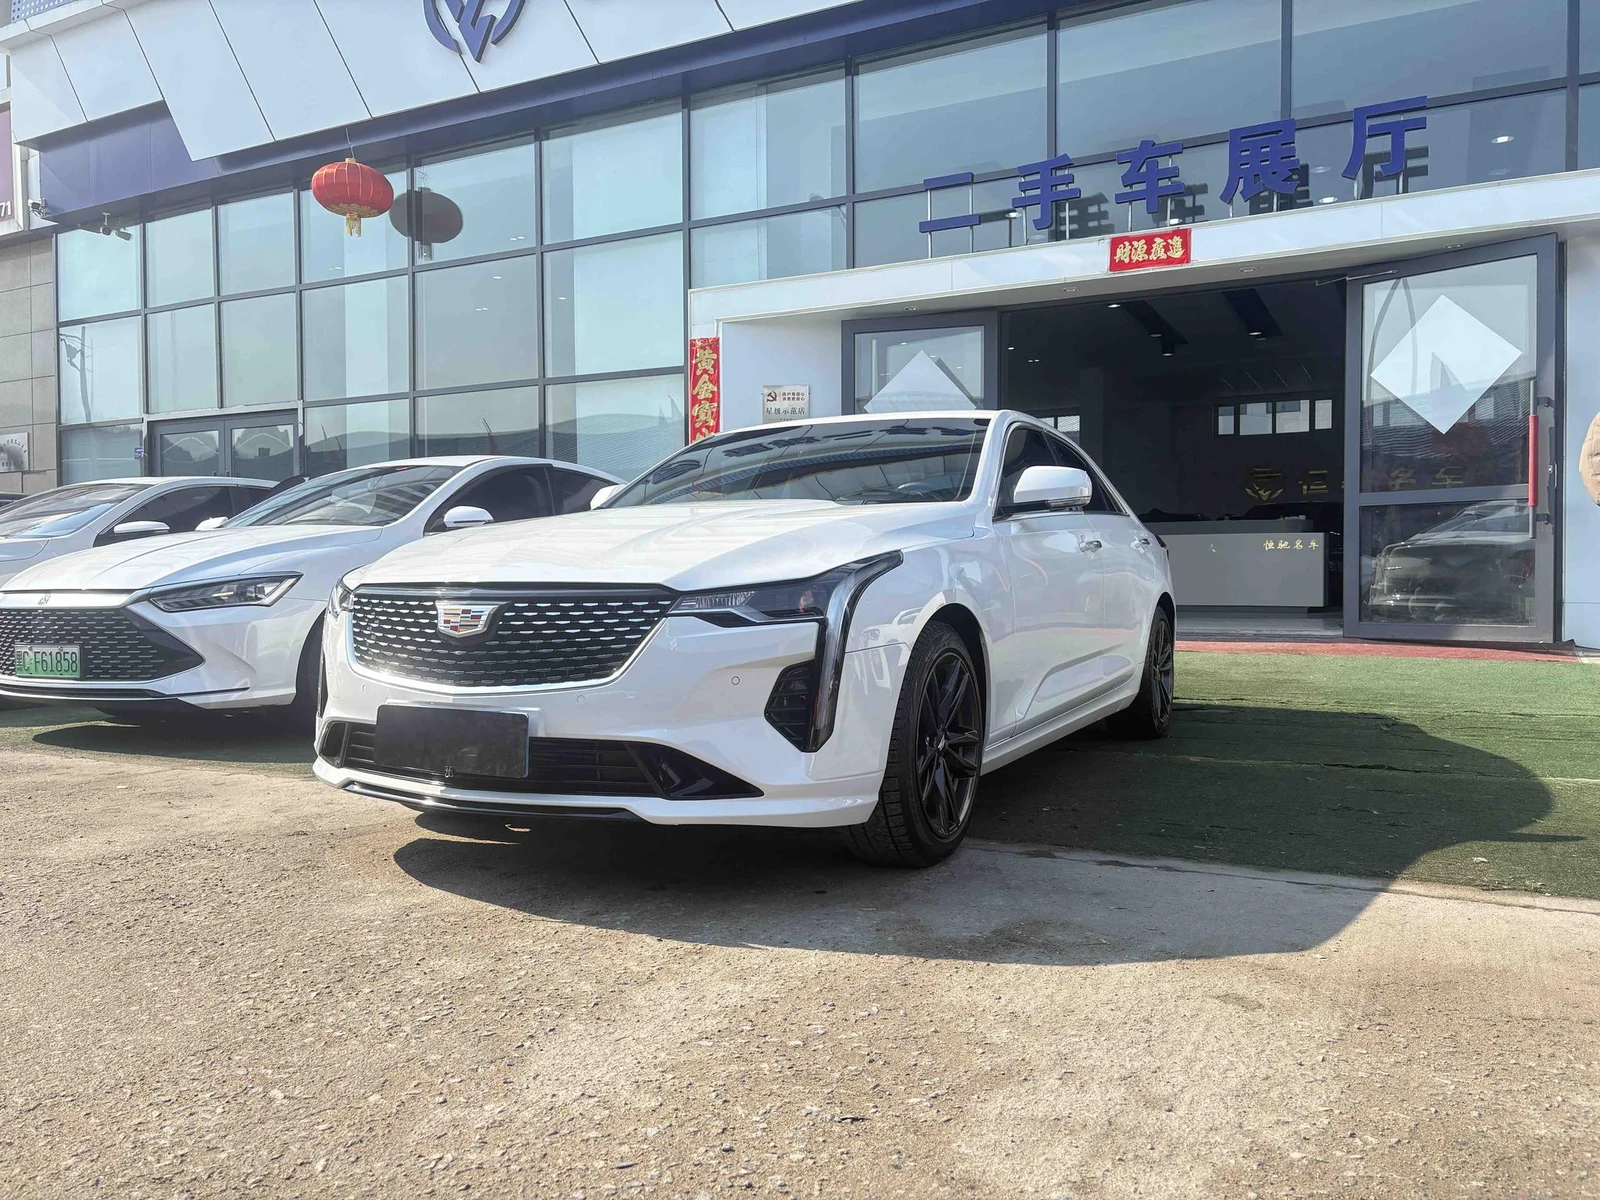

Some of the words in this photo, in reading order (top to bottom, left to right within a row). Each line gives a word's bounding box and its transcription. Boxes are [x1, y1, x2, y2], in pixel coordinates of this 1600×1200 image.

[919, 95, 1428, 234] 二手车展厅
[766, 406, 805, 415] 星级示范店
[1263, 539, 1319, 551] 恒驰名车
